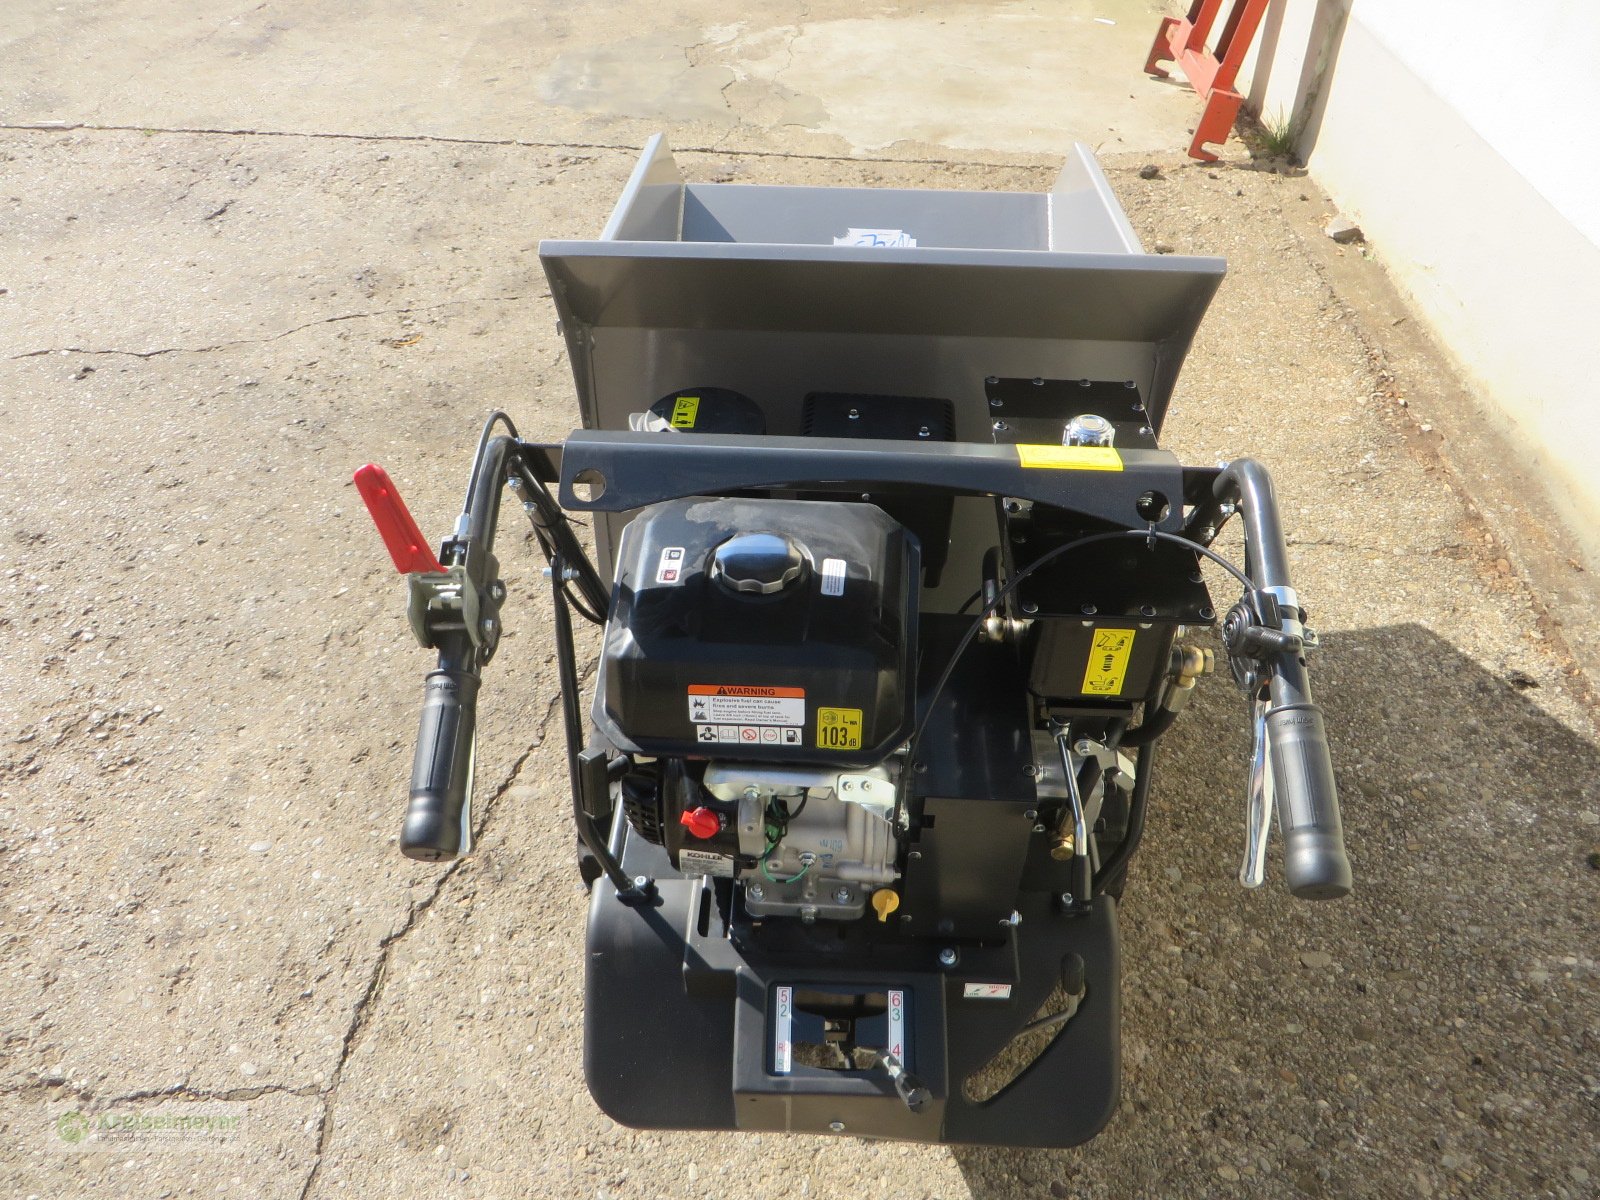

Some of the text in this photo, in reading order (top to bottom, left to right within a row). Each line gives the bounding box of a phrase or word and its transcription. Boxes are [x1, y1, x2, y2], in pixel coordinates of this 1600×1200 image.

[727, 688, 776, 696] WARNING
[822, 726, 857, 746] 103 dB
[688, 852, 722, 860] KOHLER
[780, 990, 788, 1003] 5
[892, 993, 900, 1007] 6
[780, 1005, 787, 1017] 2
[892, 1008, 900, 1021] 3
[892, 1044, 900, 1056] 4
